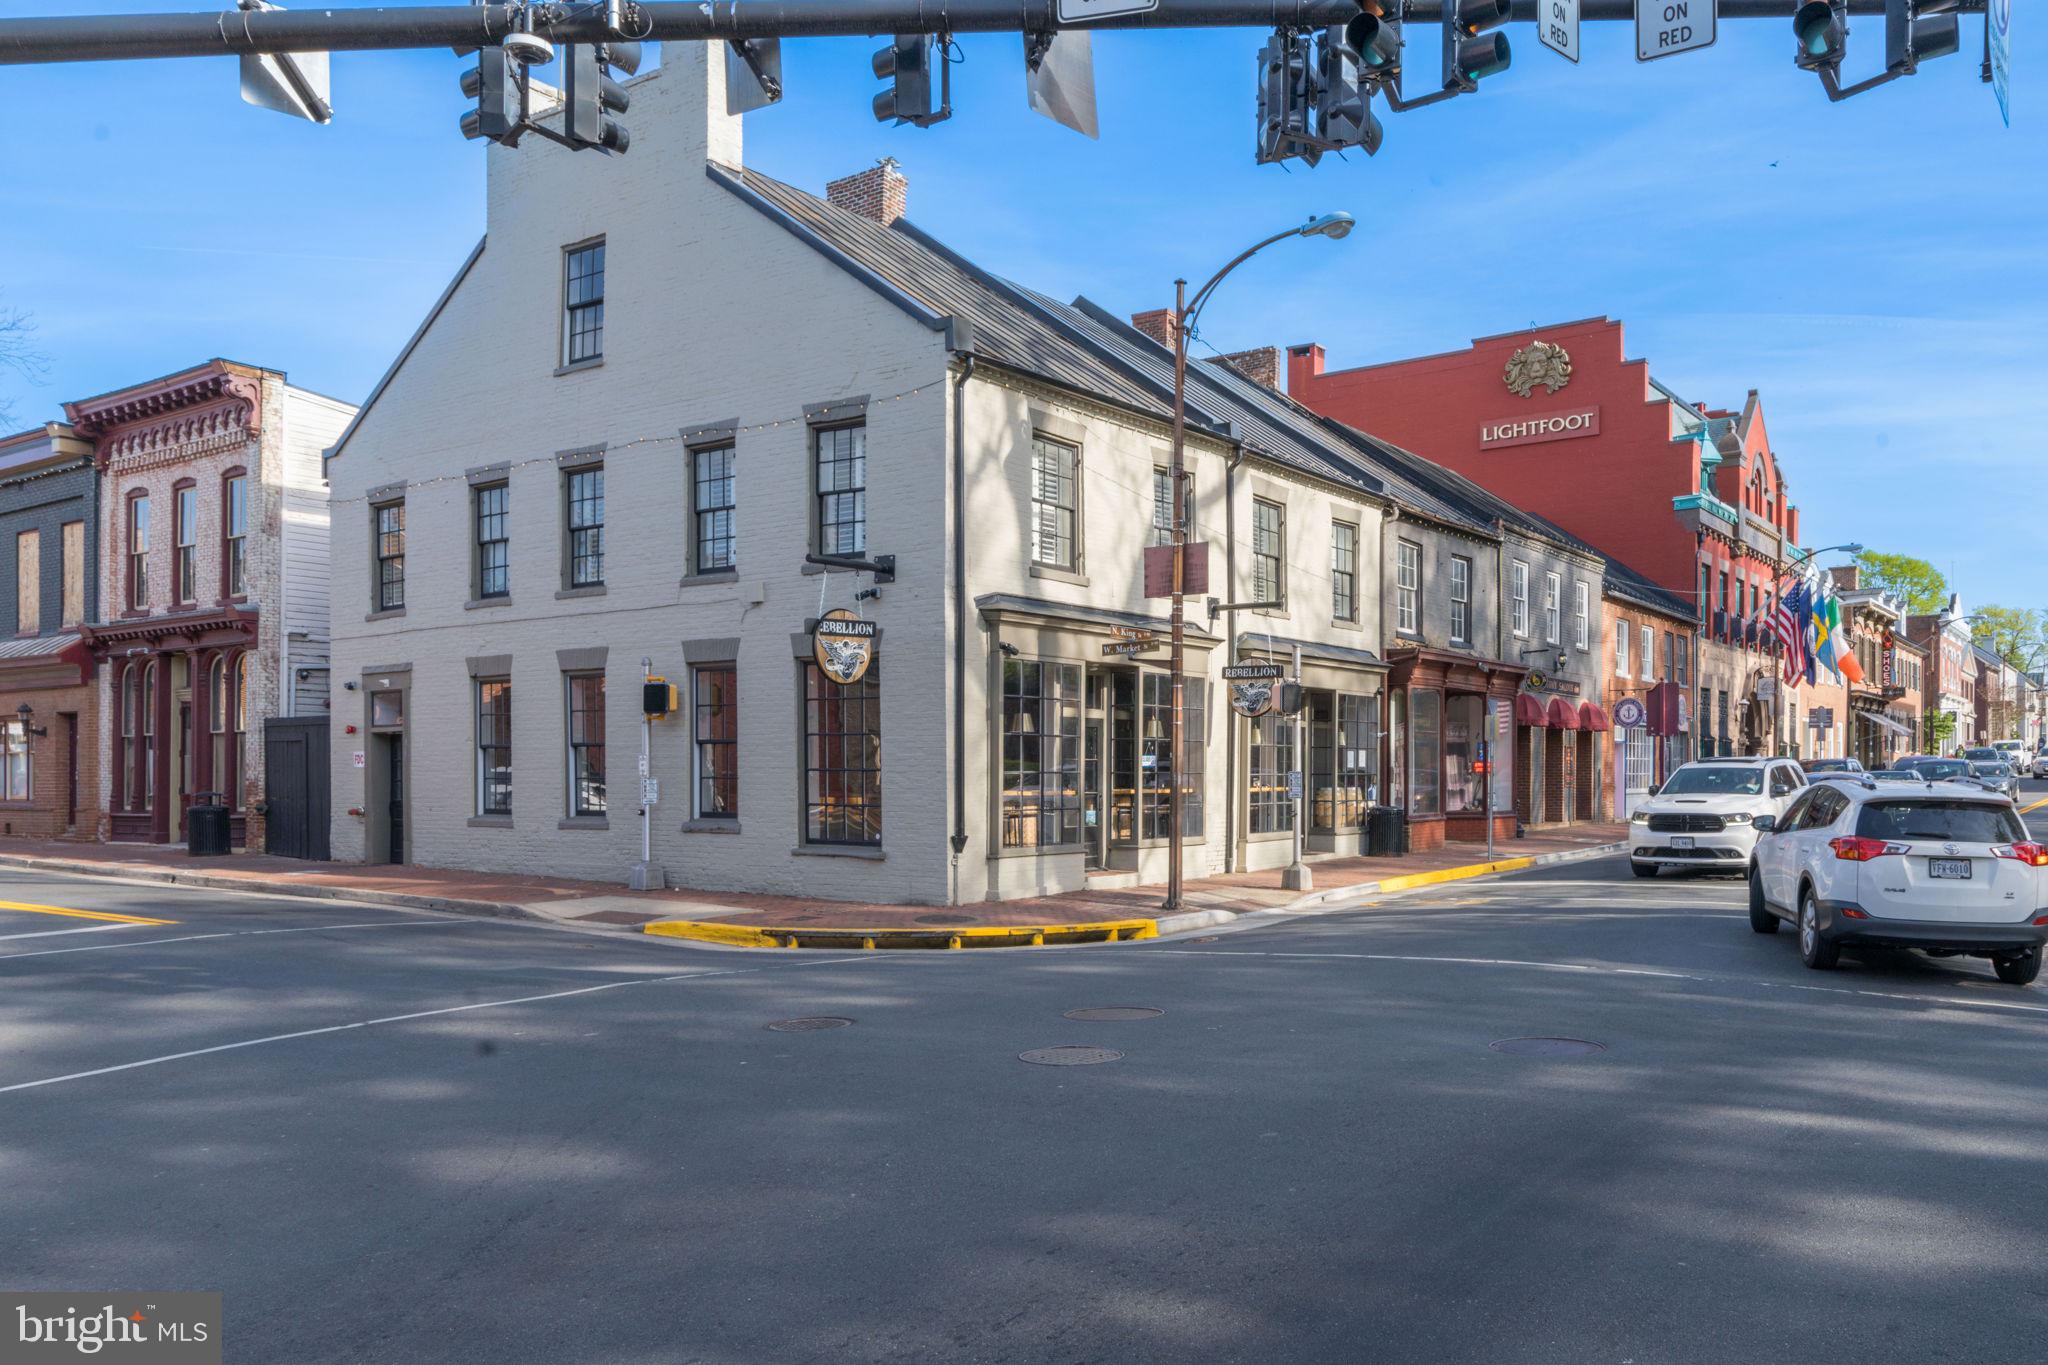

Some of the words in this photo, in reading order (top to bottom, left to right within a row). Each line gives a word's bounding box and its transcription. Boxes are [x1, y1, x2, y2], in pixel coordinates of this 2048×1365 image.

[1552, 2, 1566, 24] ON
[1663, 2, 1688, 22] ON
[1550, 23, 1568, 48] RED
[1658, 26, 1692, 48] RED
[1482, 412, 1594, 441] LIGHTFOOT
[820, 620, 873, 635] EBELLION
[1115, 643, 1142, 653] Market
[1225, 666, 1277, 678] REBELLION
[1882, 650, 1890, 687] SHOES
